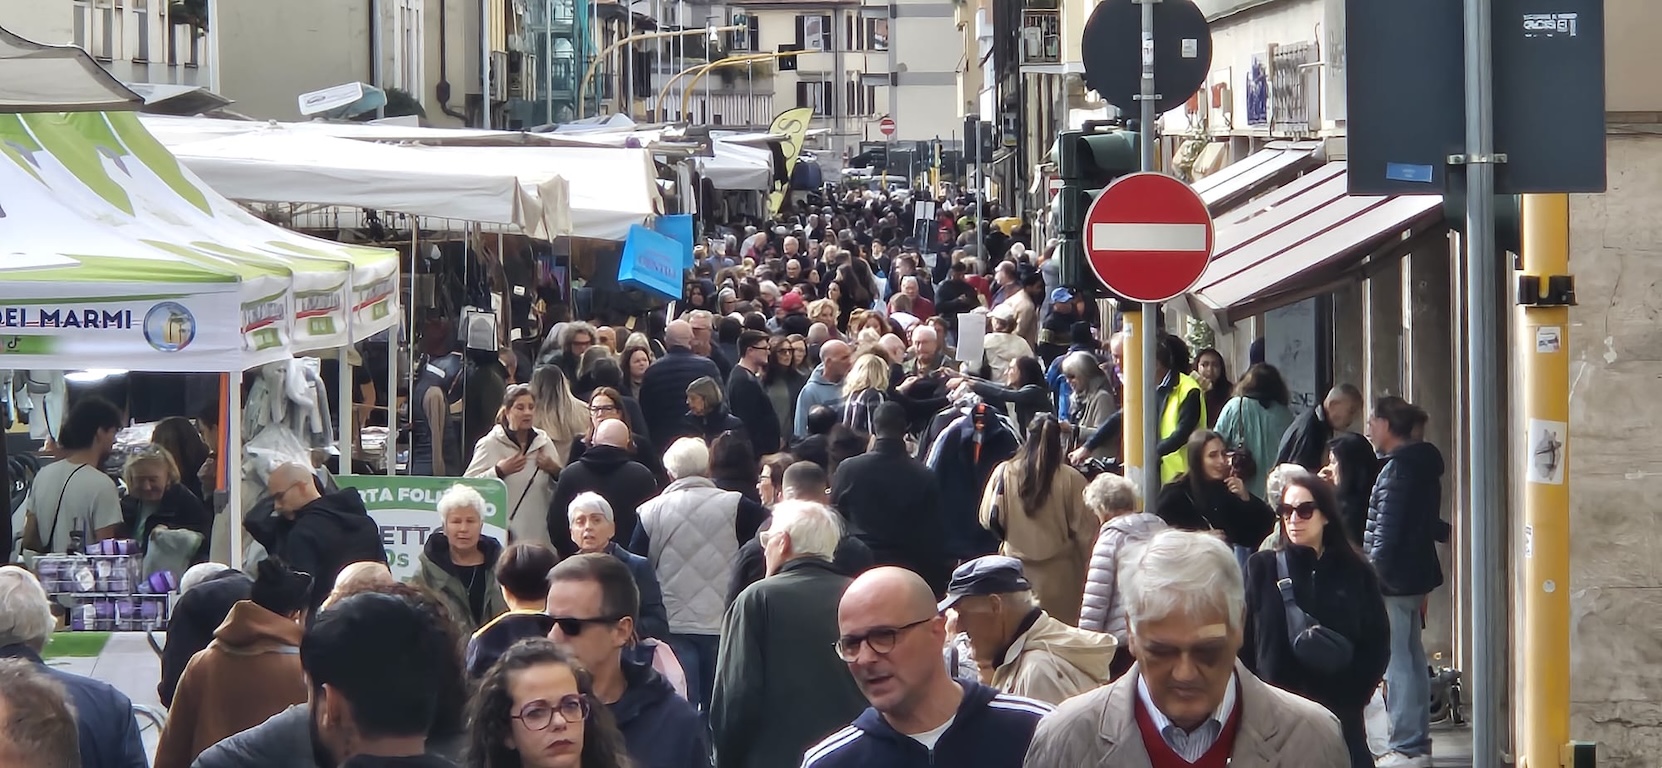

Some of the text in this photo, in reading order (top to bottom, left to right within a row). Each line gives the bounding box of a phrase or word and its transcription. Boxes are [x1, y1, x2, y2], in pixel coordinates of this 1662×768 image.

[0, 308, 131, 329] EI MARMI
[379, 525, 444, 545] ETT
